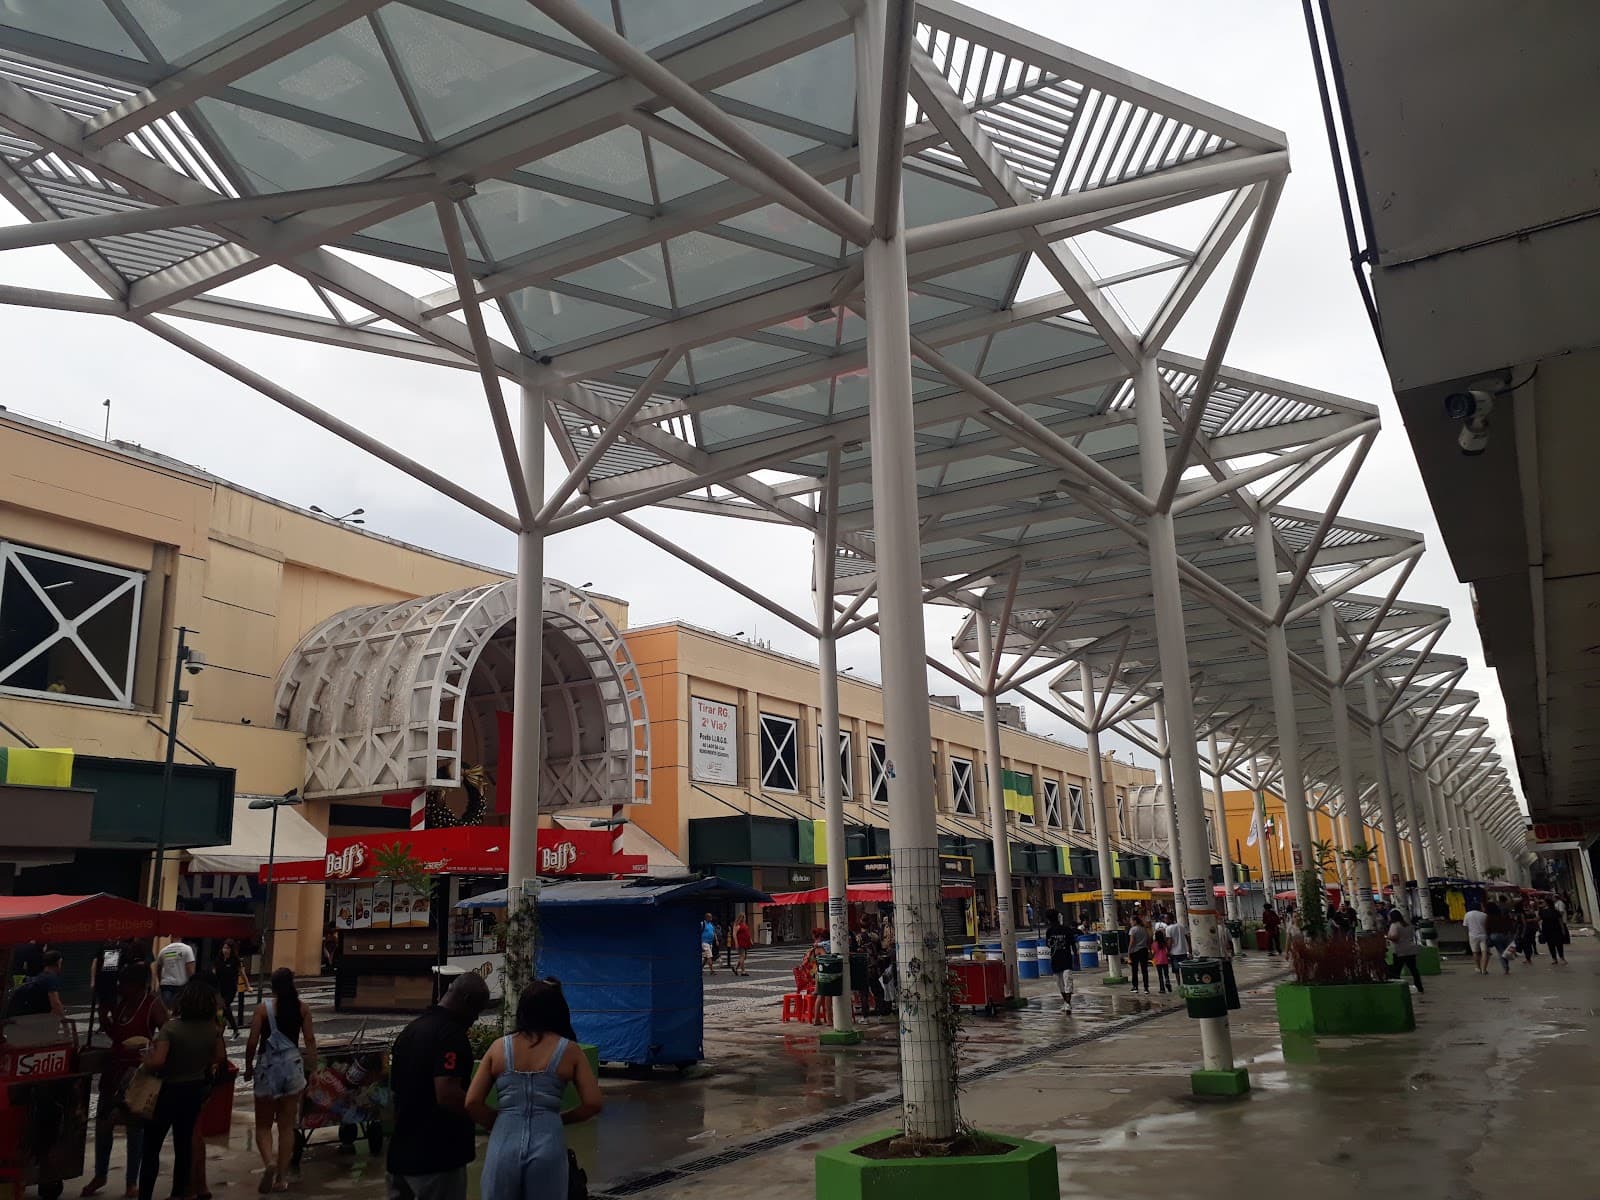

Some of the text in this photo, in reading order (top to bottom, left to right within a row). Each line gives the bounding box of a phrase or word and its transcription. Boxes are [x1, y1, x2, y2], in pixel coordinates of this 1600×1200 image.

[698, 702, 728, 717] Tirar RG
[711, 719, 728, 731] Via?
[325, 844, 364, 878] Baff's
[541, 842, 577, 872] Baff's
[19, 1053, 64, 1075] Sadia
[443, 1051, 457, 1070] 3
